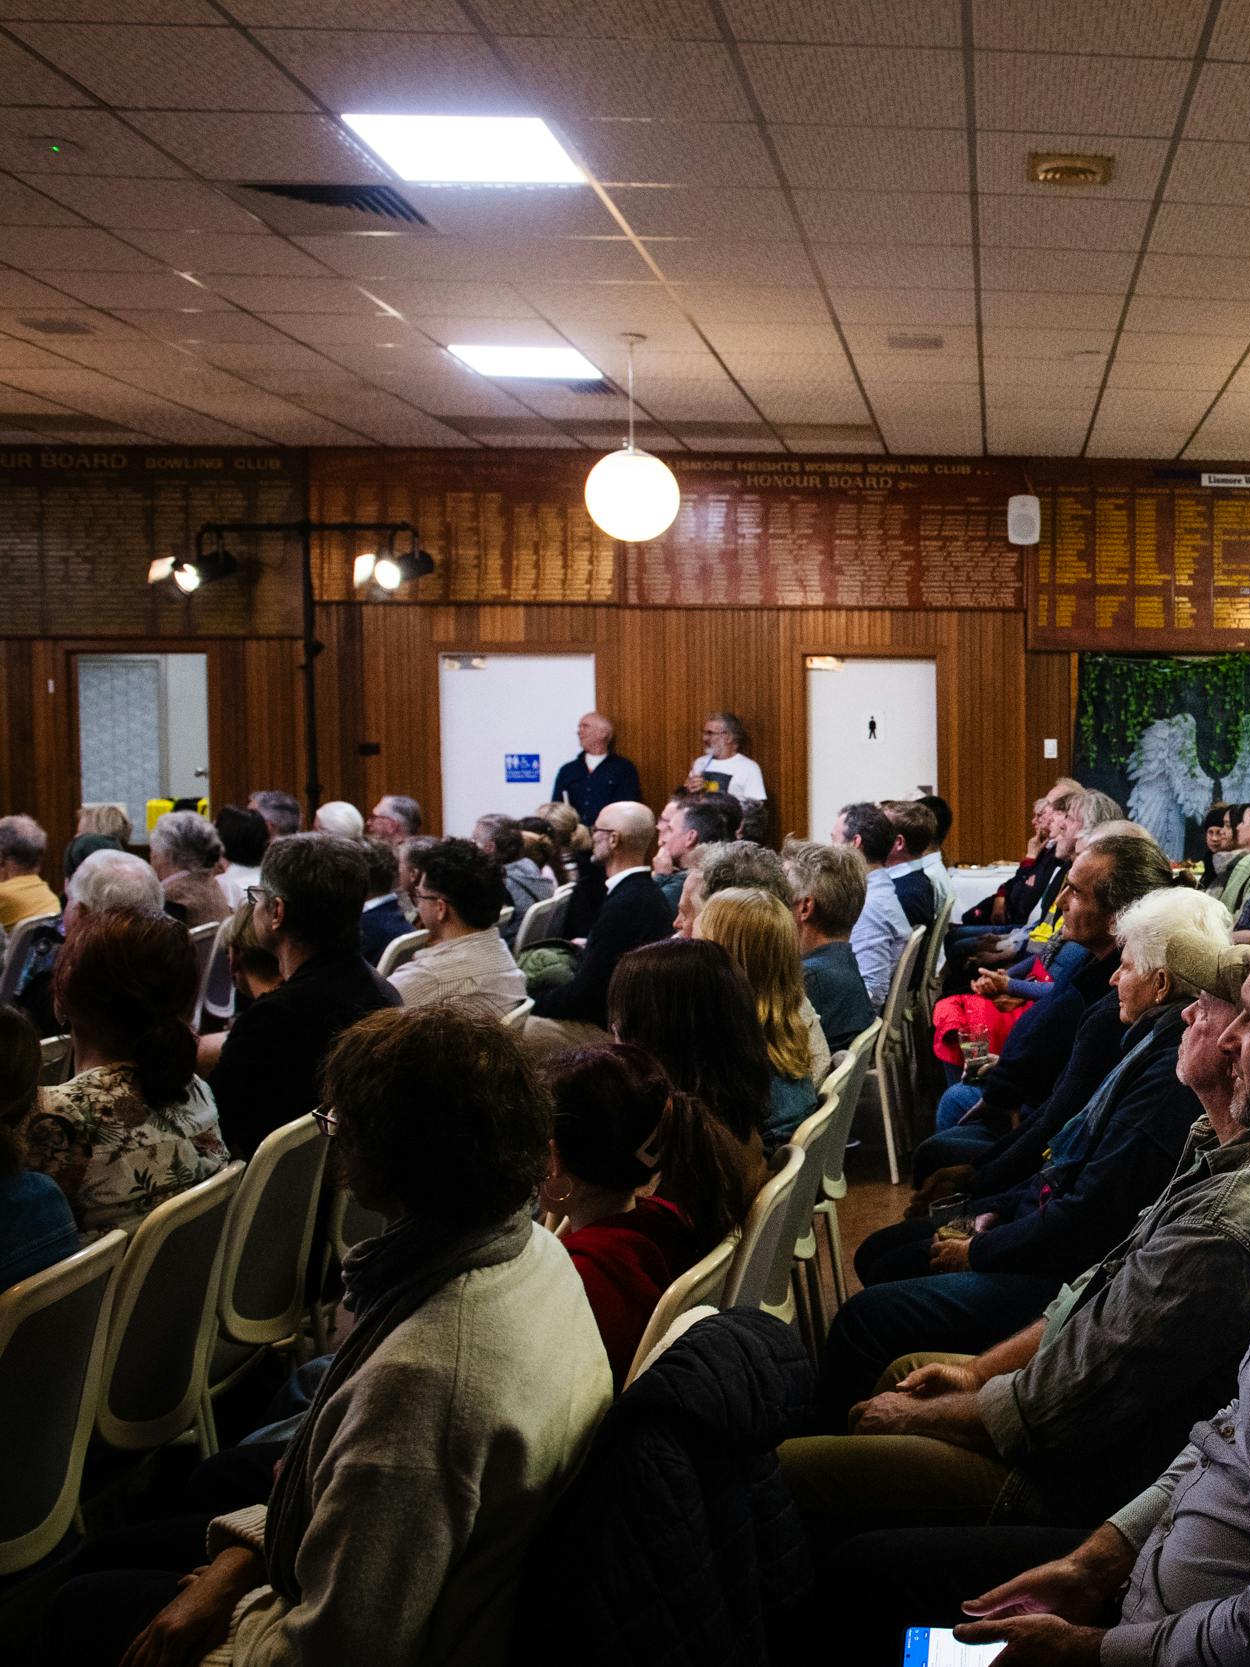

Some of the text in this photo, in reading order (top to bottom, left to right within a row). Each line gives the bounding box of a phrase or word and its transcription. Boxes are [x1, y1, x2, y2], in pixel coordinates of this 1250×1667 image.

[42, 452, 127, 468] BOARD
[145, 457, 282, 469] BOWLING CLUB
[737, 462, 800, 472] HEIGHTS
[867, 464, 929, 474] BOWLING
[934, 465, 971, 475] CLUB
[746, 474, 893, 489] HONOUR BOARD
[1208, 475, 1242, 485] Lismore
